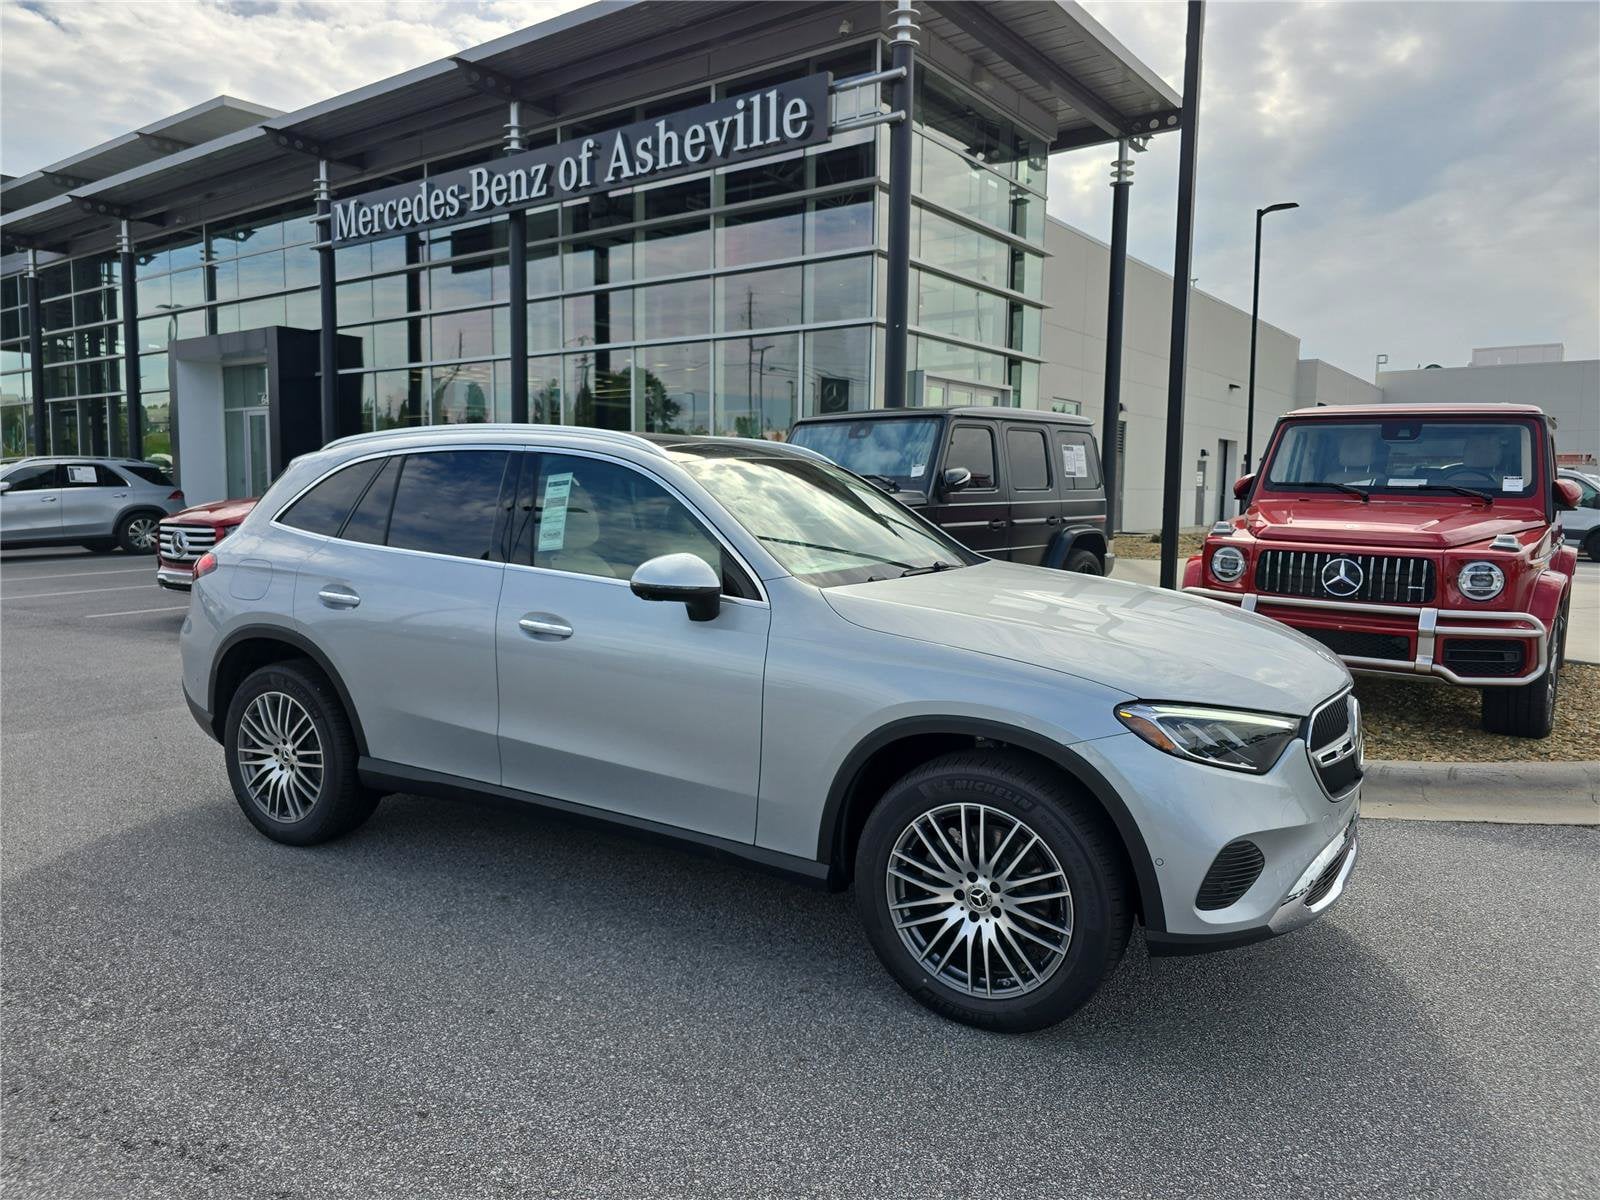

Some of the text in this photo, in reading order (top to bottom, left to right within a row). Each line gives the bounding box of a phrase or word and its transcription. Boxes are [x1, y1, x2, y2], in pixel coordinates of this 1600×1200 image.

[334, 89, 808, 241] Mercedes-Benz of Asheville
[954, 779, 1033, 810] MICHELIN
